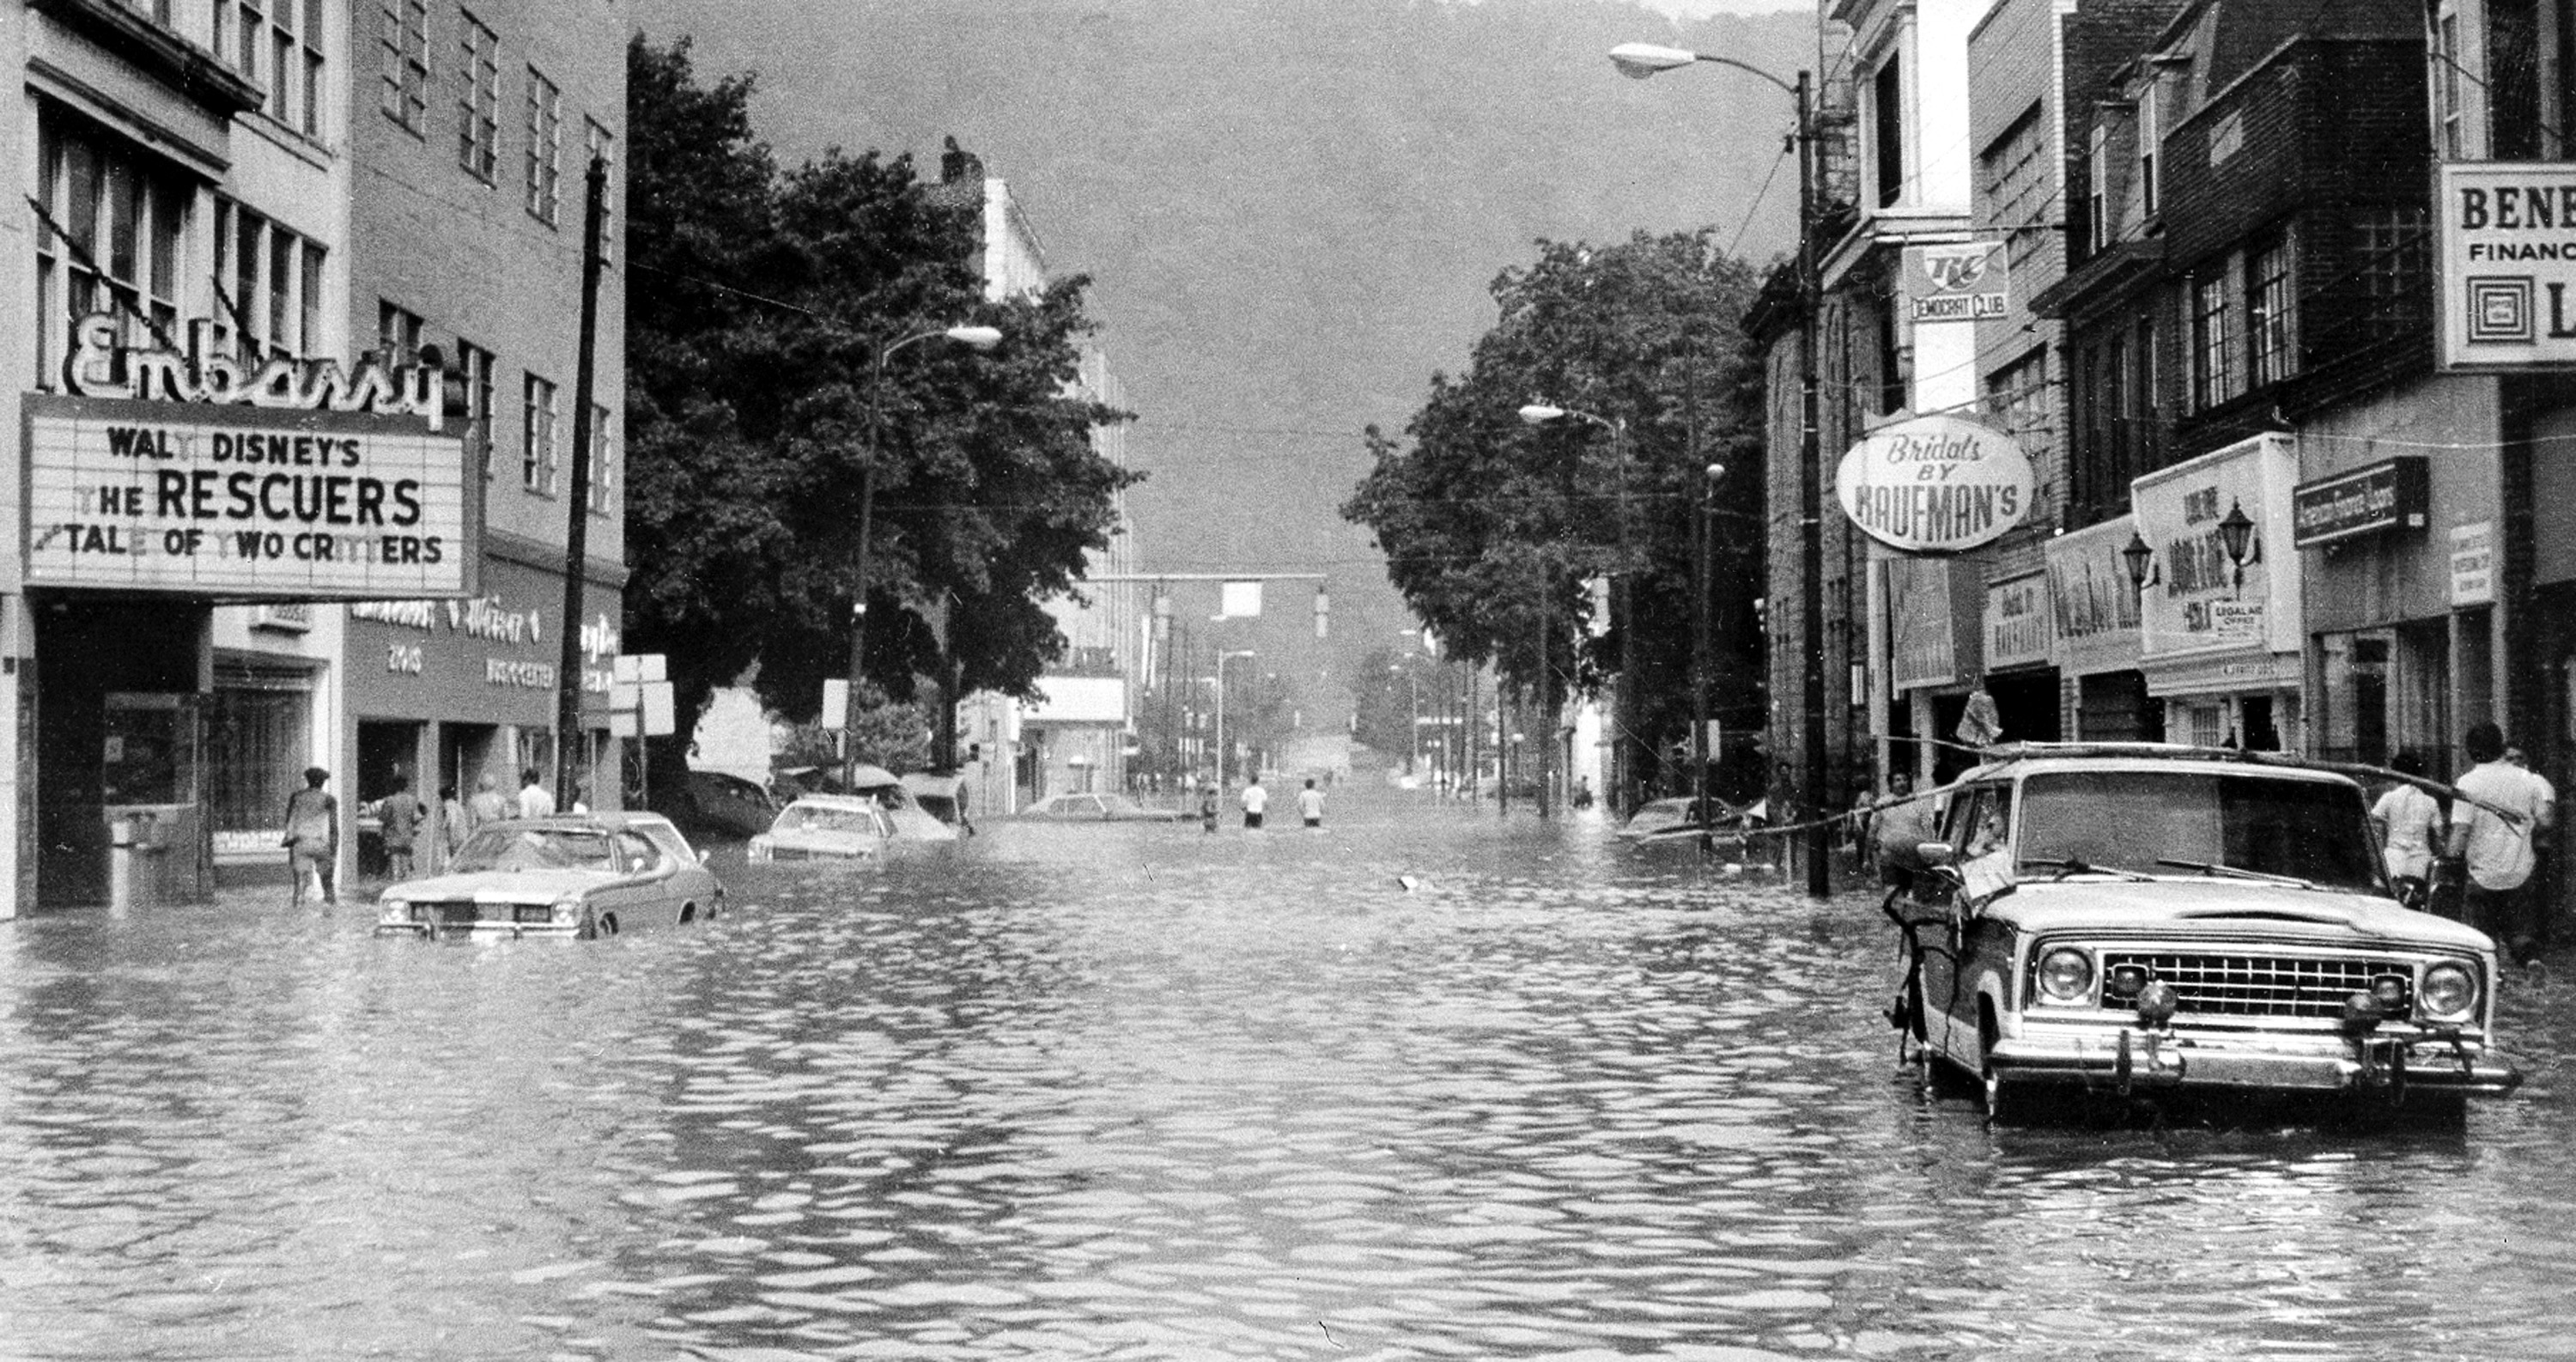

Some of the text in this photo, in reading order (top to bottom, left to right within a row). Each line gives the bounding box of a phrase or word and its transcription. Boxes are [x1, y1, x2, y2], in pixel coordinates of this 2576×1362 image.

[2470, 243, 2576, 261] FINANC
[1911, 295, 2005, 319] DEMOCRAT CLUB
[72, 313, 443, 430] Embassy
[107, 428, 360, 467] WALT DISNEY'S
[1887, 434, 1981, 464] Bridals
[1917, 464, 1957, 481] BY
[74, 469, 421, 526] THE RESCUERS
[1856, 484, 2017, 542] KAUFMAN'S
[164, 529, 204, 556] OF
[216, 531, 284, 561] TWO
[293, 532, 442, 564] CRITTERS
